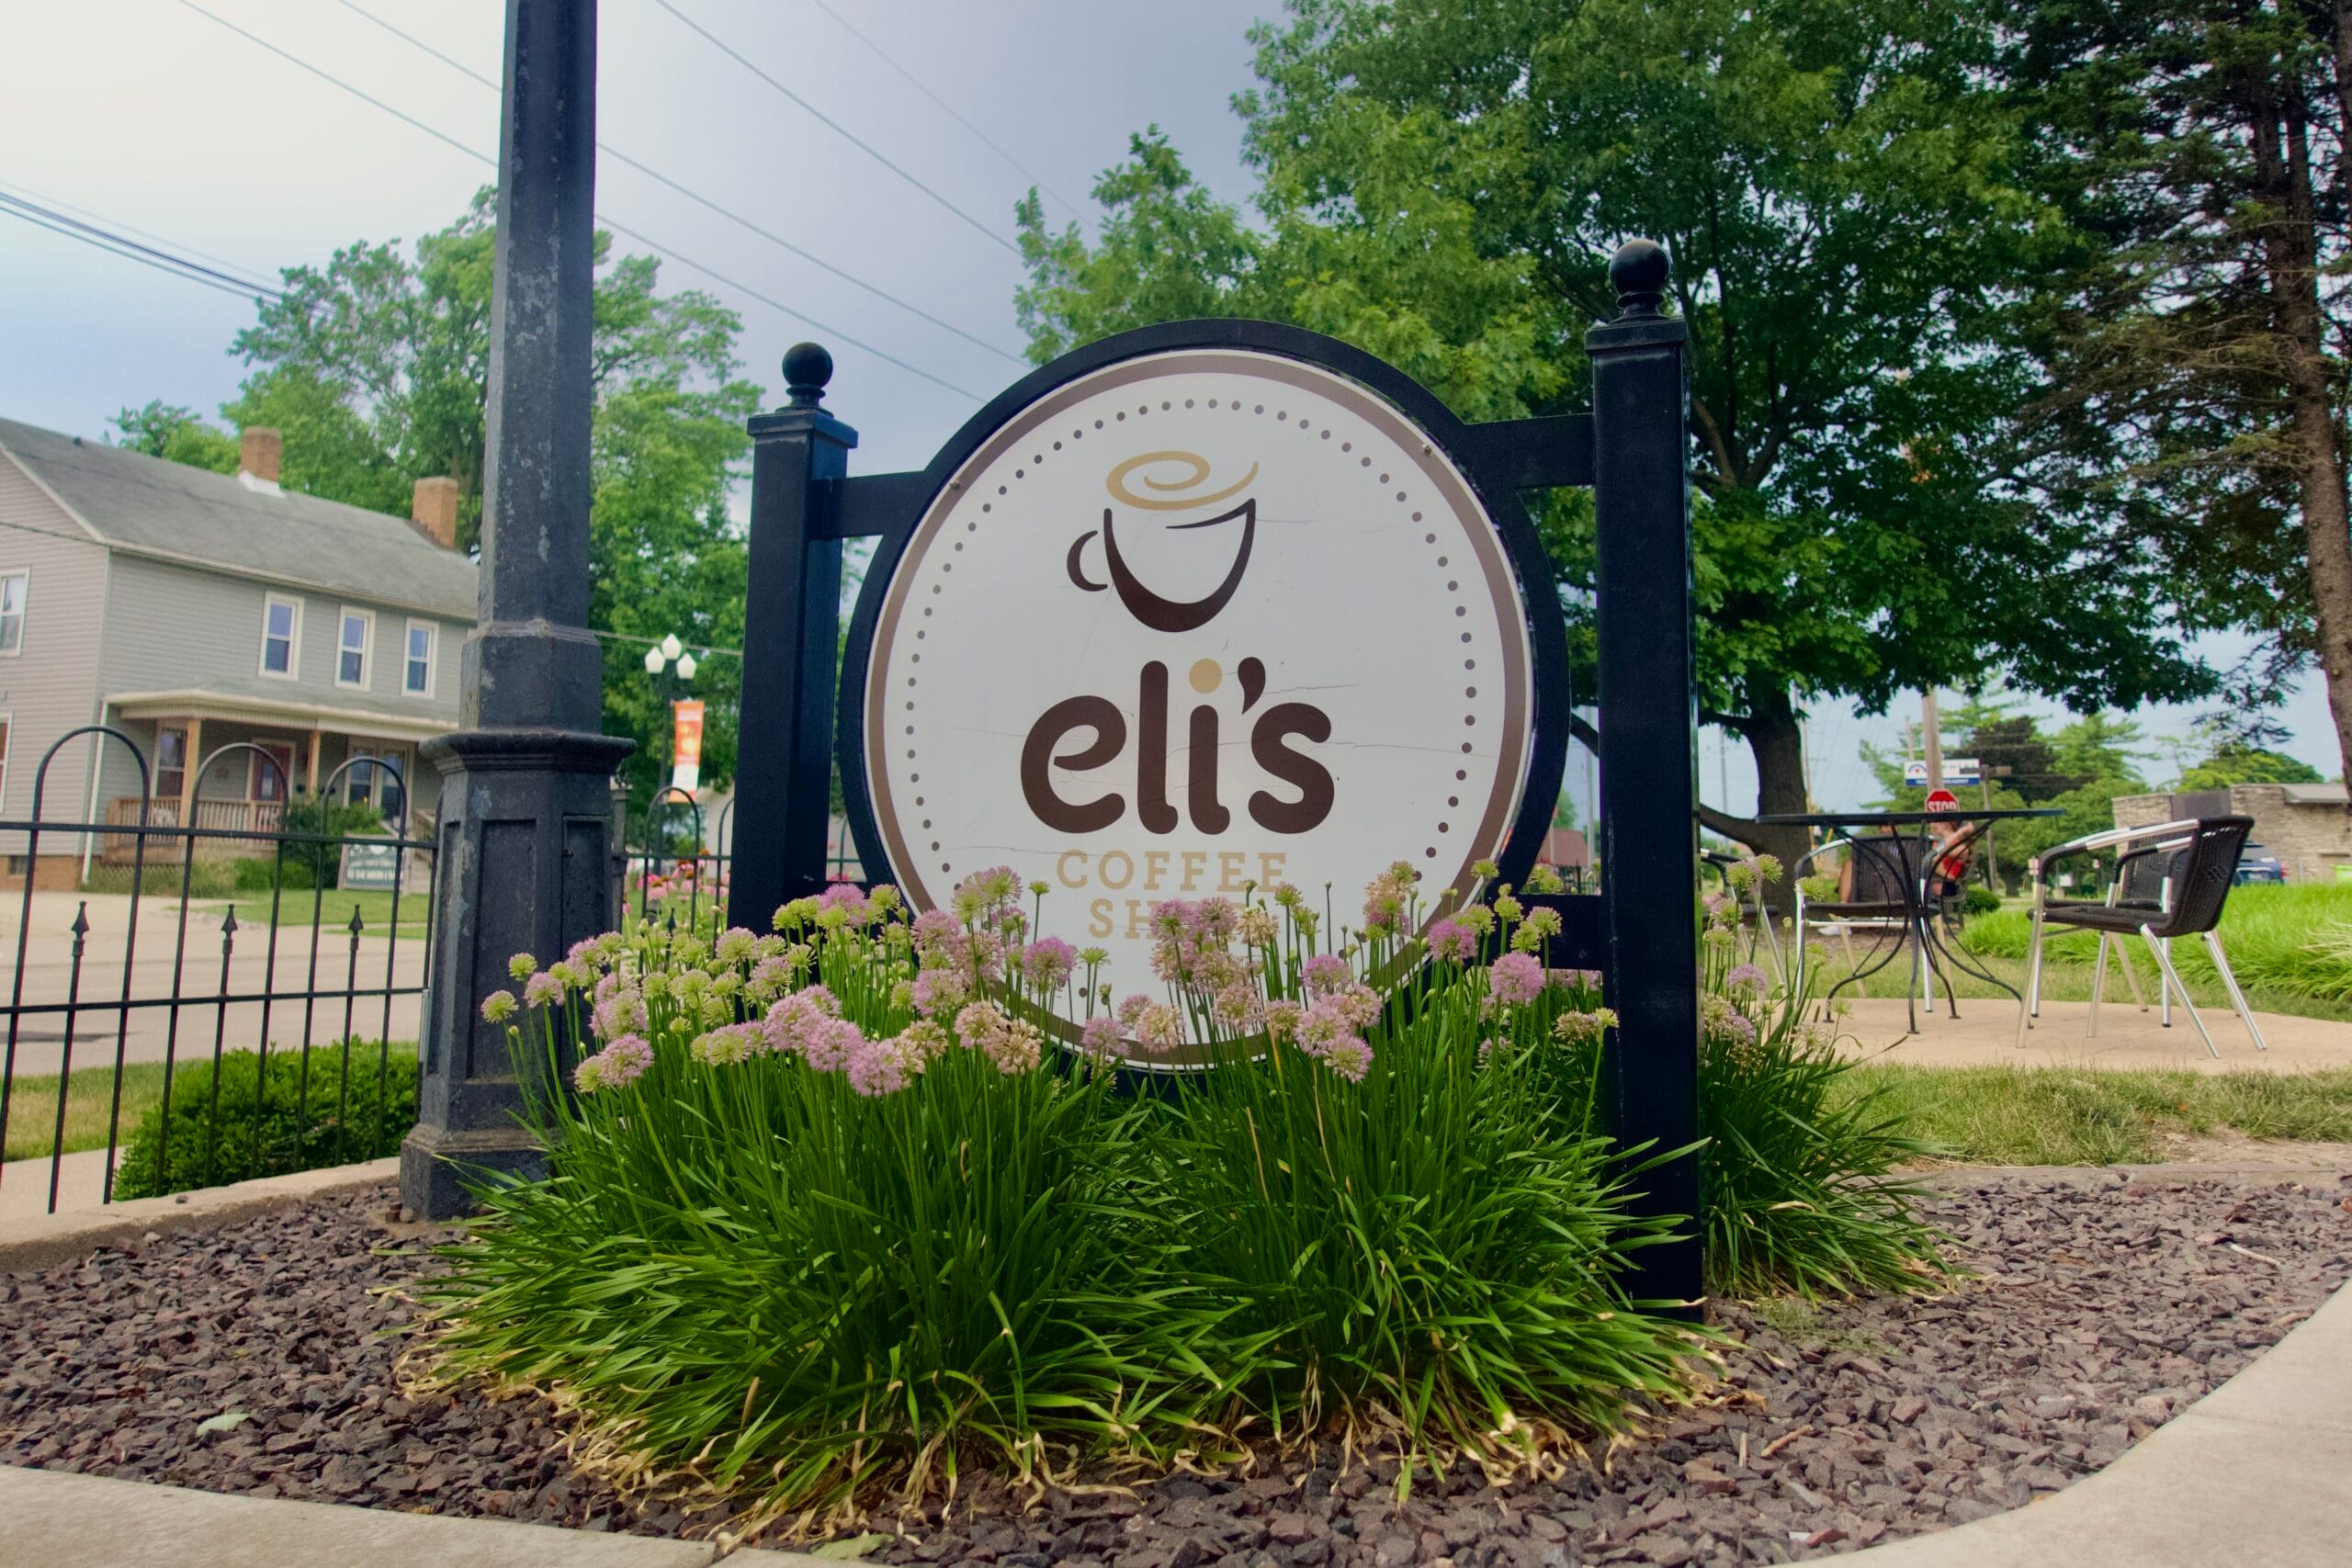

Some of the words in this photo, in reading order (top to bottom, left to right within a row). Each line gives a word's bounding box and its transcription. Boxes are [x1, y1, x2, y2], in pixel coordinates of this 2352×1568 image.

[1021, 657, 1335, 835] eli's
[1928, 800, 1958, 813] STOP
[1057, 849, 1286, 893] COFFEE
[1089, 897, 1247, 940] SH
